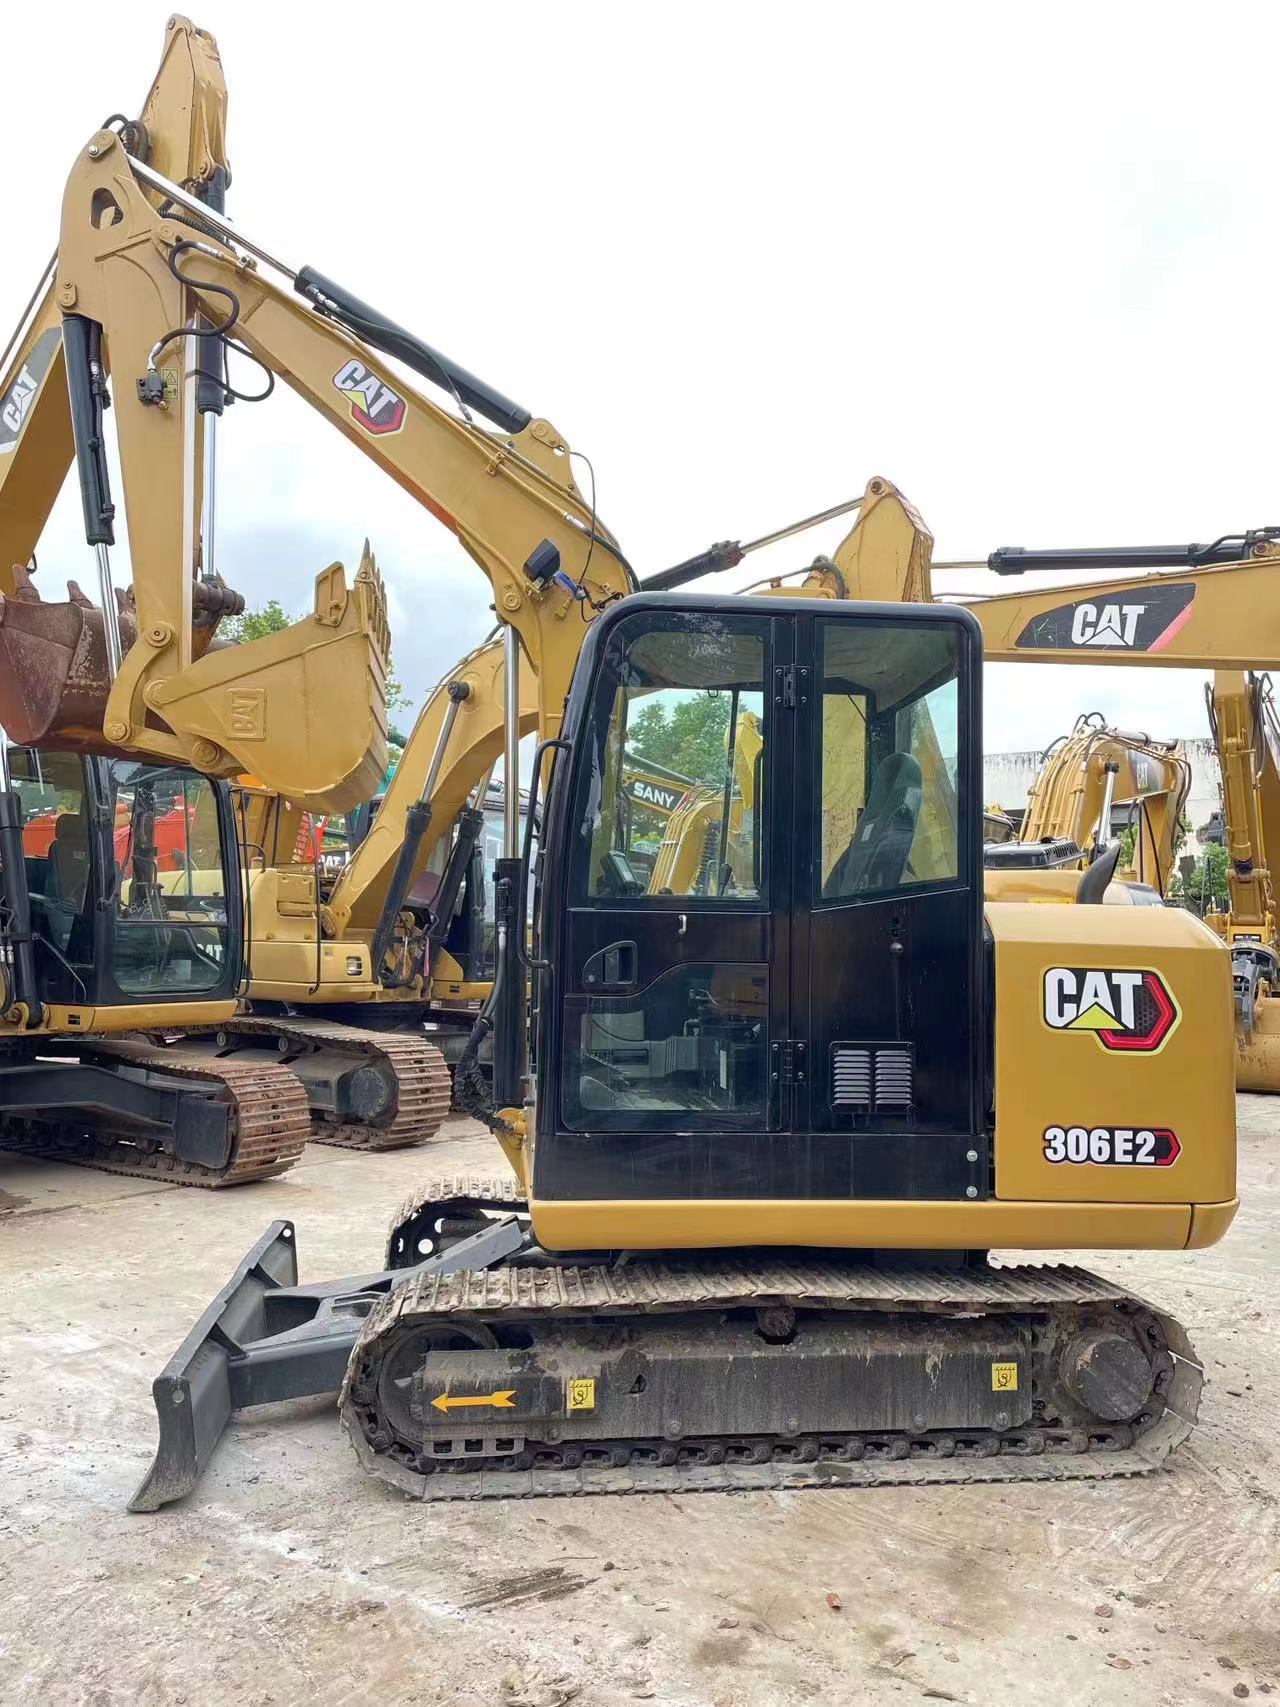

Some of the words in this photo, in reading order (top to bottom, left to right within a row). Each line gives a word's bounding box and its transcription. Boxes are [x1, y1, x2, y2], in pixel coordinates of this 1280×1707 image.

[3, 363, 38, 432] CAT
[334, 360, 399, 418] CAT
[1071, 603, 1145, 646] CAT
[633, 781, 675, 808] SANY
[197, 944, 222, 961] AT
[1045, 968, 1143, 1030] CAT
